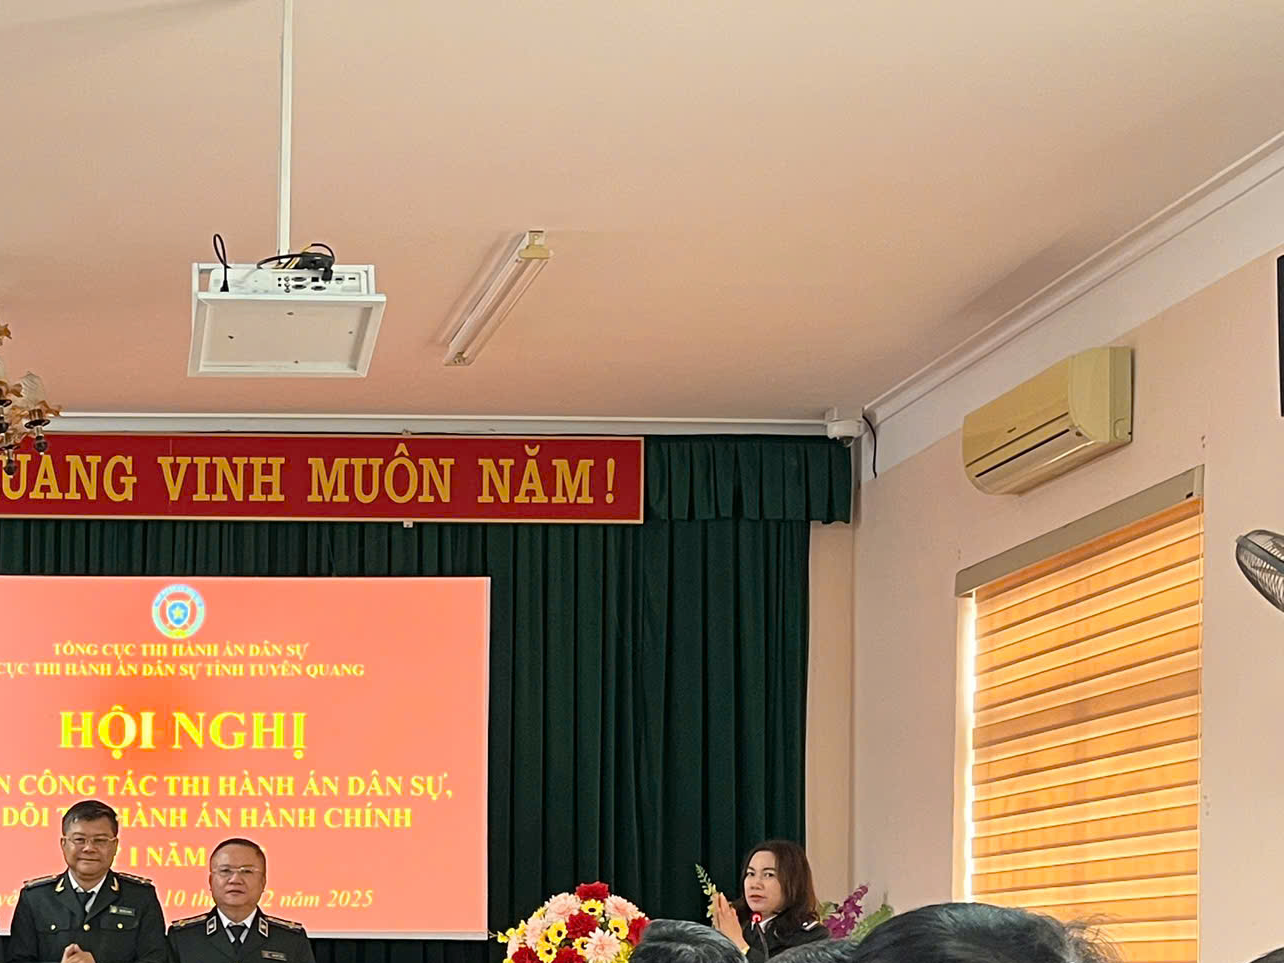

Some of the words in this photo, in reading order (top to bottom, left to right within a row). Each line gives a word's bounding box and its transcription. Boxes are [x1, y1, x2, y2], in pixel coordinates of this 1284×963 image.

[157, 456, 285, 503] VINH
[307, 442, 454, 504] MUÔN
[102, 643, 137, 660] CỤC
[141, 643, 167, 656] THI
[172, 640, 218, 657] HÀNH
[222, 640, 245, 657] ÁN
[249, 640, 281, 657] DÂN
[286, 642, 309, 661] SỰ
[34, 663, 61, 676] THI
[65, 660, 112, 676] HÀNH
[142, 660, 175, 676] DÂN
[179, 662, 202, 680] SỰ
[249, 660, 302, 677] TUYÊN
[306, 663, 365, 679] QUANG
[59, 704, 156, 760] HỘI
[172, 711, 307, 760] NGHỊ
[18, 769, 96, 796] CÔNG
[102, 770, 157, 796] TÁC
[164, 775, 210, 796] THI
[218, 770, 295, 796] HÀNH
[302, 770, 340, 796] ÁN
[347, 769, 403, 796] DÂN
[409, 772, 453, 800] SỰ,
[2, 802, 49, 827] DÕI
[195, 802, 232, 828] ÁN
[239, 802, 317, 828] HÀNH
[323, 801, 413, 828] CHÍNH
[146, 842, 206, 867] NĂM
[164, 888, 187, 907] 10
[279, 889, 320, 908] năm
[327, 889, 374, 908] 2025
